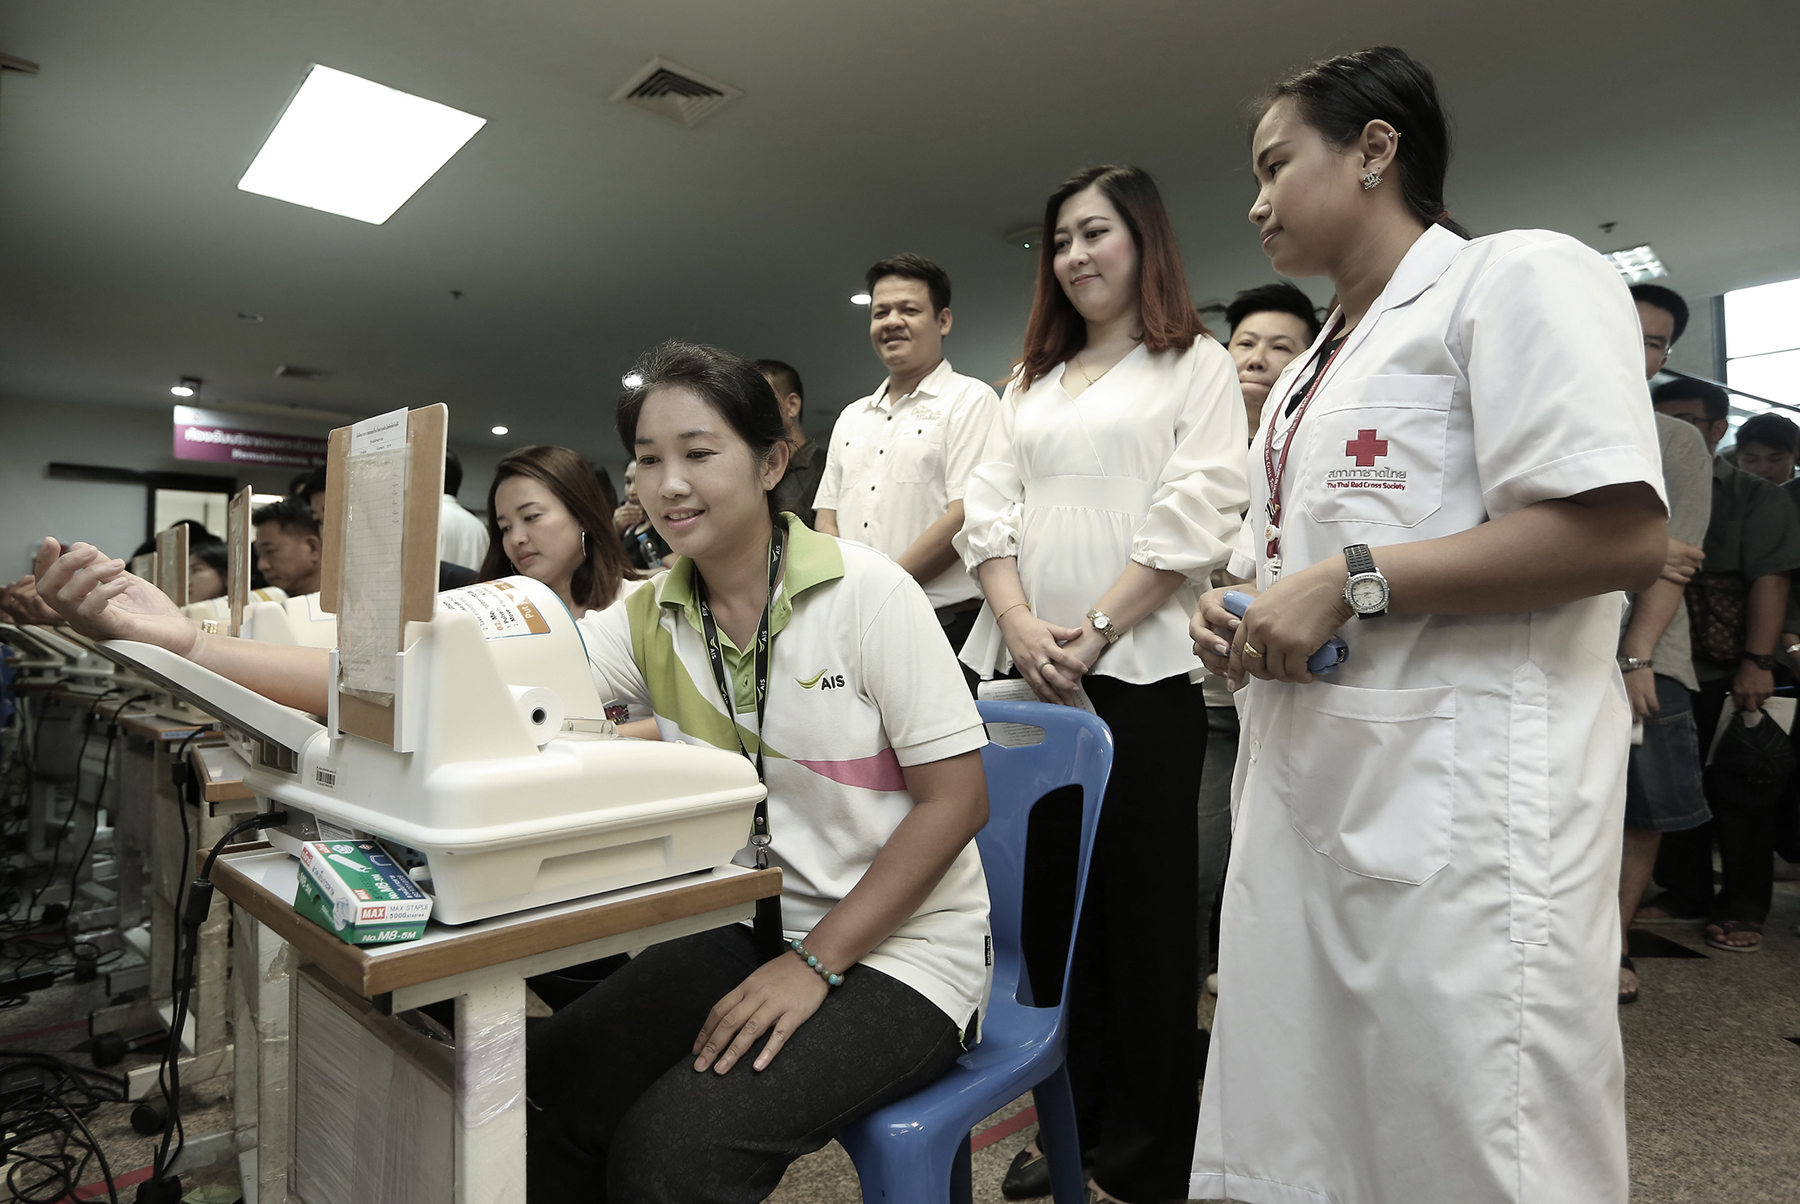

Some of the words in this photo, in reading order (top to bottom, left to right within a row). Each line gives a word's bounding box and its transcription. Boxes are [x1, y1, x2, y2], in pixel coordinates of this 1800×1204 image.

[1265, 461, 1273, 478] Cross
[1363, 481, 1382, 489] Cross
[1382, 483, 1406, 491] Society
[521, 605, 535, 619] Put
[709, 647, 717, 660] AIS
[820, 674, 846, 691] AIS
[361, 907, 386, 919] MAX
[406, 903, 429, 911] STAPLE
